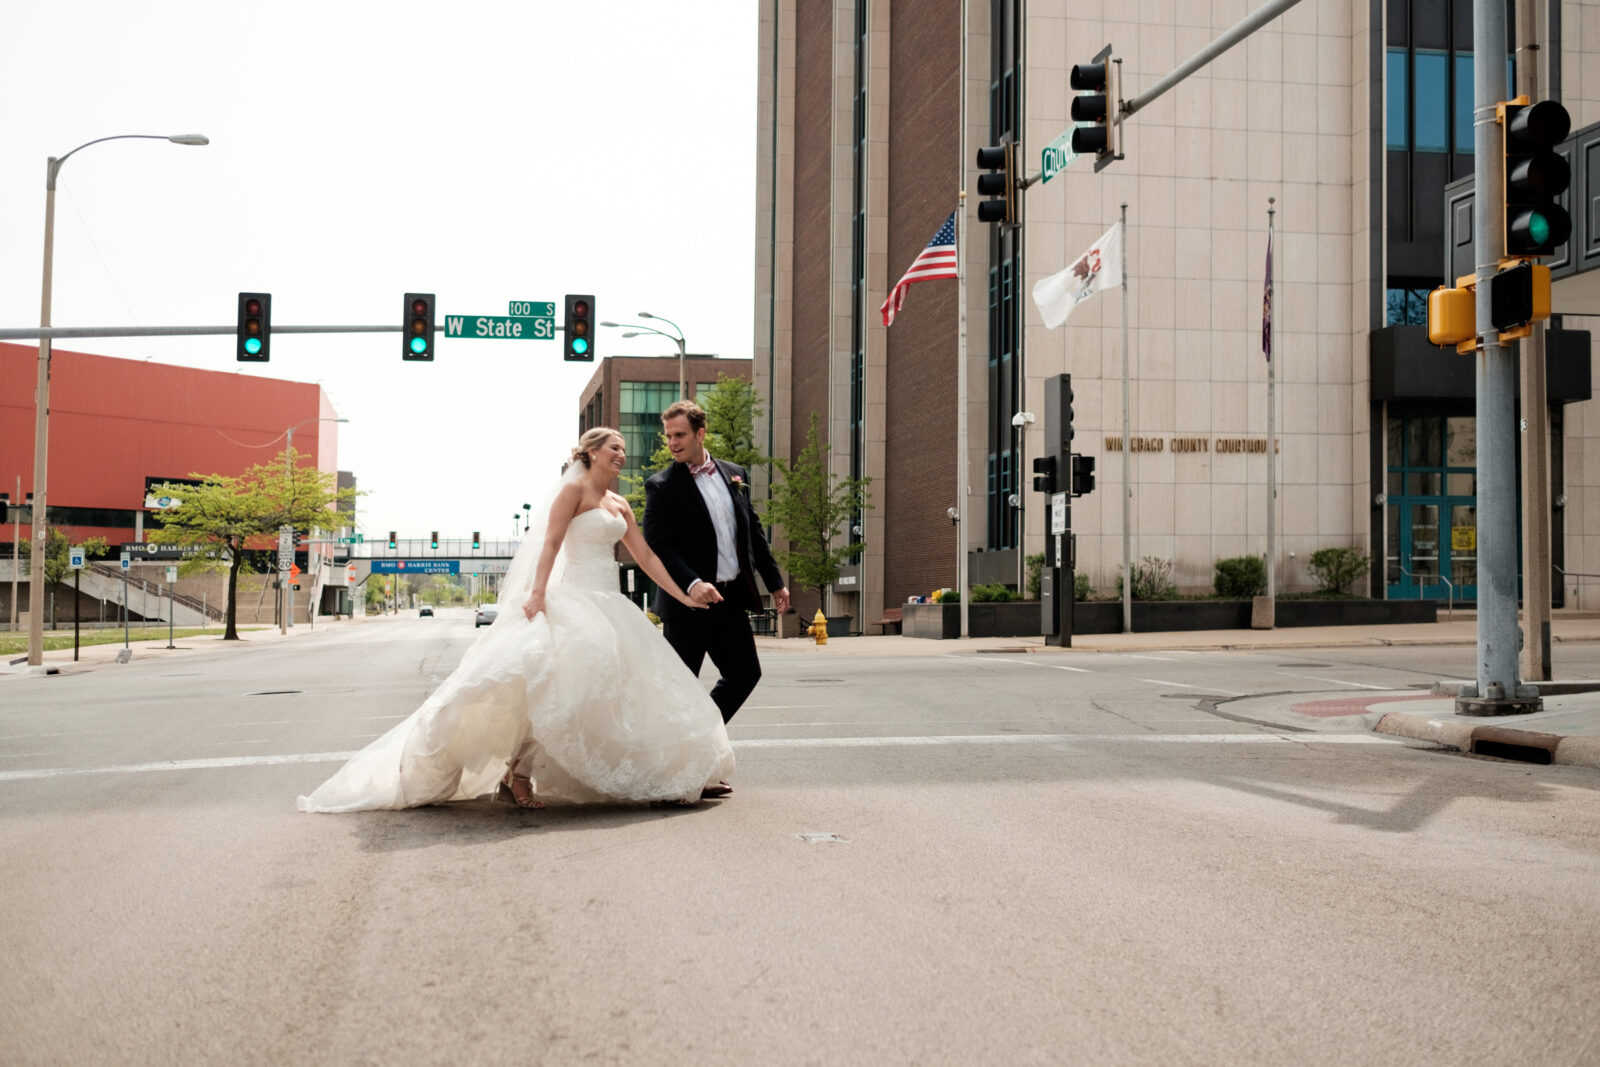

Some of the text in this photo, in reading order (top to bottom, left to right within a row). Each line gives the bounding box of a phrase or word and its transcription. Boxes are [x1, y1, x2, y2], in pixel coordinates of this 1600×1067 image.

[510, 302, 554, 316] 100 S
[447, 316, 553, 338] W State St
[1104, 436, 1279, 454] WINEBAGO COUNTY COURTHOUE
[280, 560, 291, 568] 20
